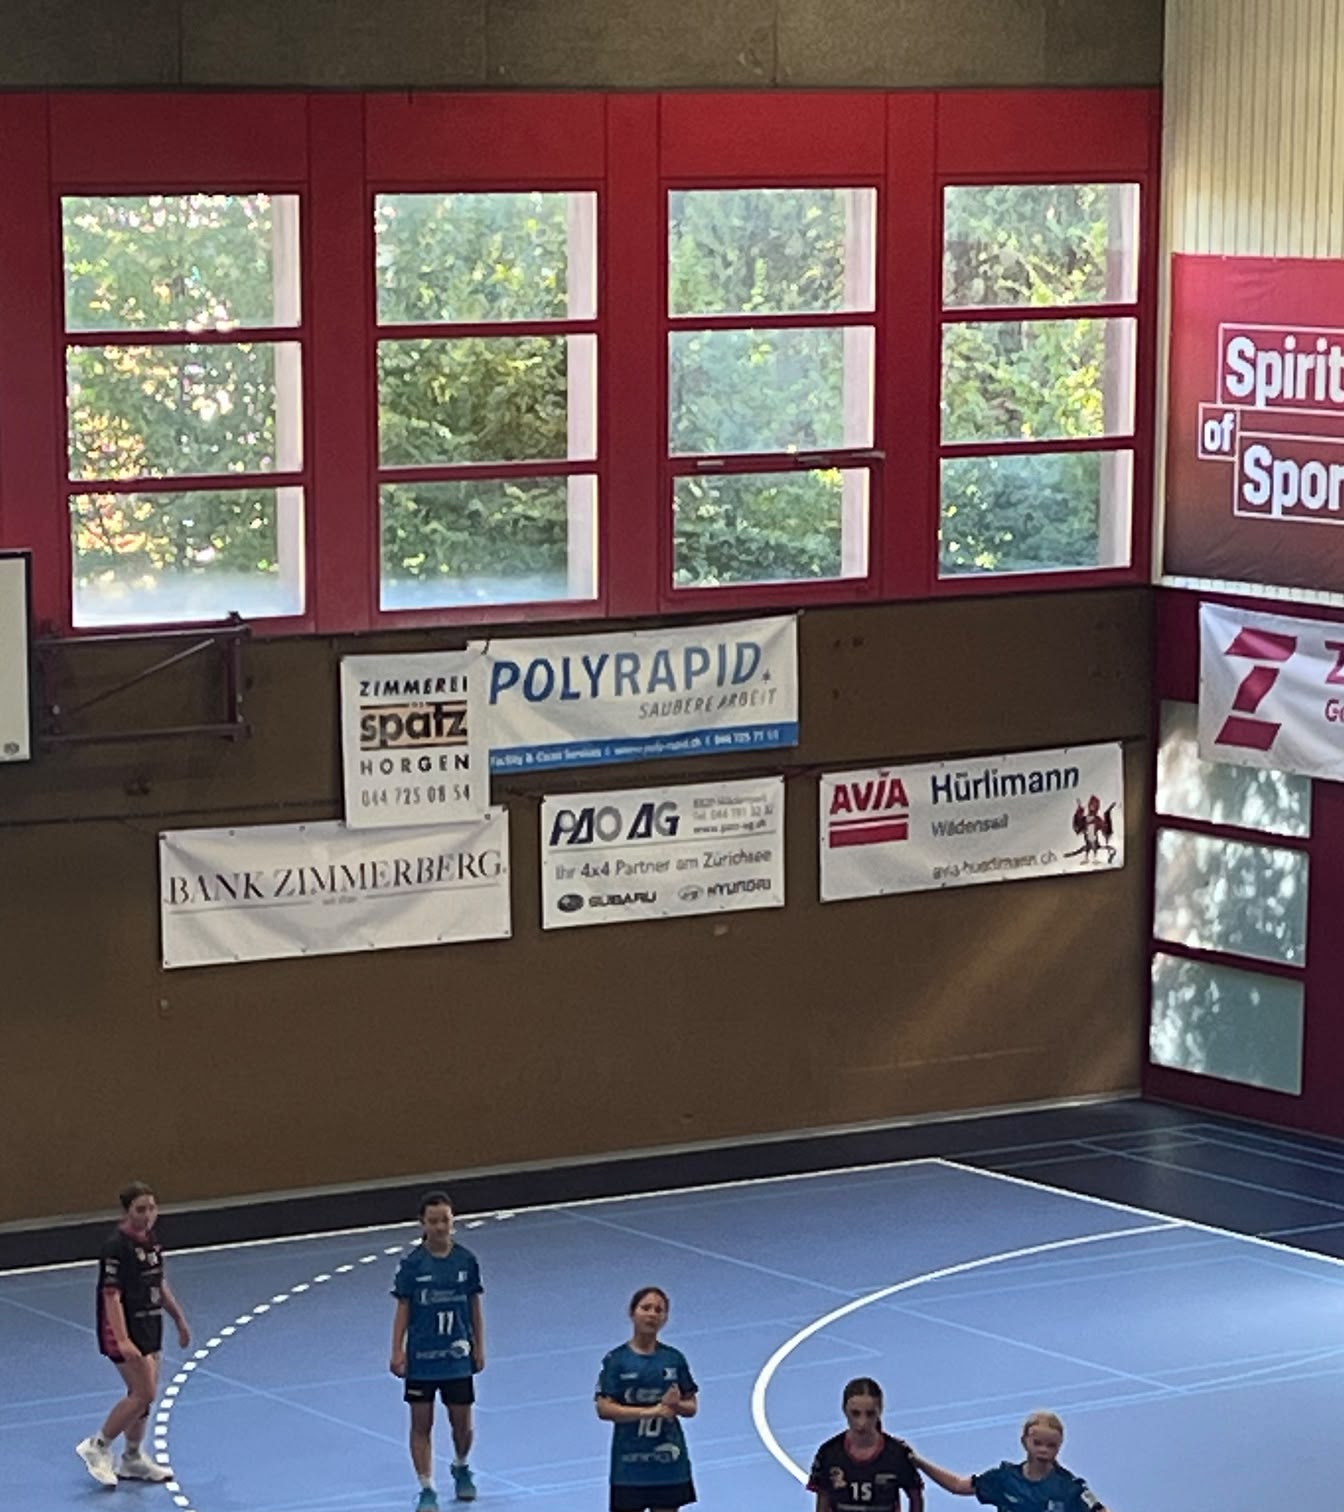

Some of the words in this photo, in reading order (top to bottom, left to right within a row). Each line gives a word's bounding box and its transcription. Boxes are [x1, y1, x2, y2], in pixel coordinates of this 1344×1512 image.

[1203, 412, 1235, 452] of
[360, 676, 468, 697] ZIMMEREI
[638, 695, 713, 719] SAUBERE
[360, 753, 469, 775] HORGEN
[829, 773, 909, 815] AVIA
[931, 766, 1080, 805] Hürlimann
[549, 805, 623, 846] PAO
[626, 801, 681, 840] AG
[168, 872, 265, 905] BANK
[273, 850, 503, 899] ZIMMERBERG
[580, 862, 611, 878] 4x4
[615, 859, 672, 877] Partner
[437, 1310, 455, 1336] 11
[850, 1481, 874, 1502] 15
